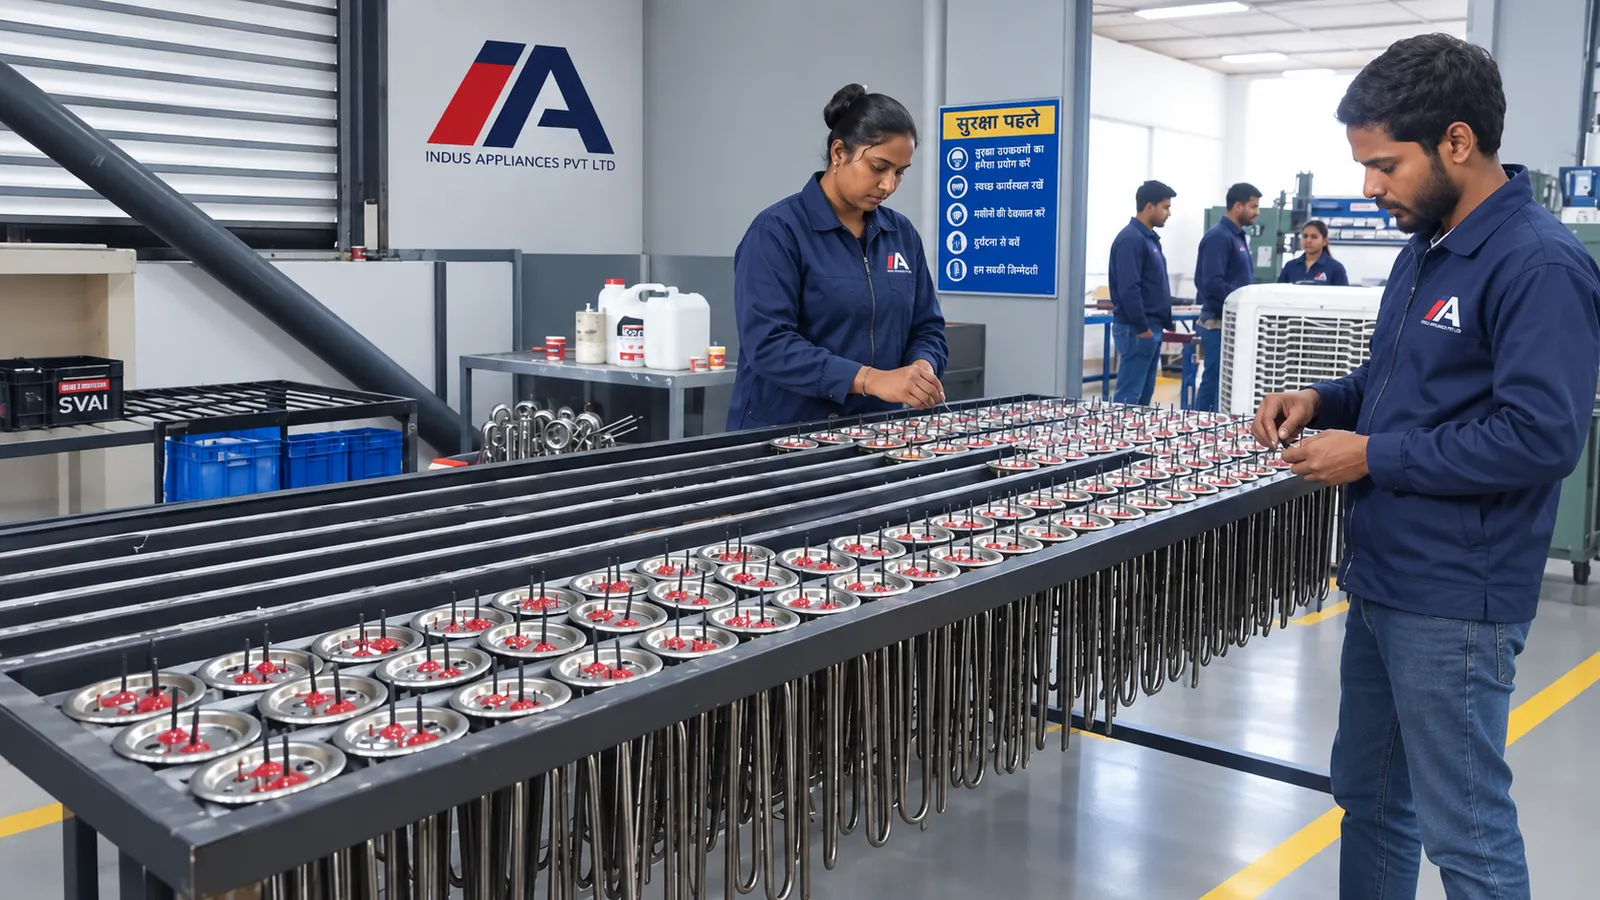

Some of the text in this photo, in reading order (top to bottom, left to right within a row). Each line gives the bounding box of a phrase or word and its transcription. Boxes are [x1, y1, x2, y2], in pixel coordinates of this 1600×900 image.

[956, 109, 1040, 136] सुरक्षा पहले
[426, 151, 616, 171] INDUS APPLIANCES PVT LTD
[59, 394, 108, 414] SVAI
